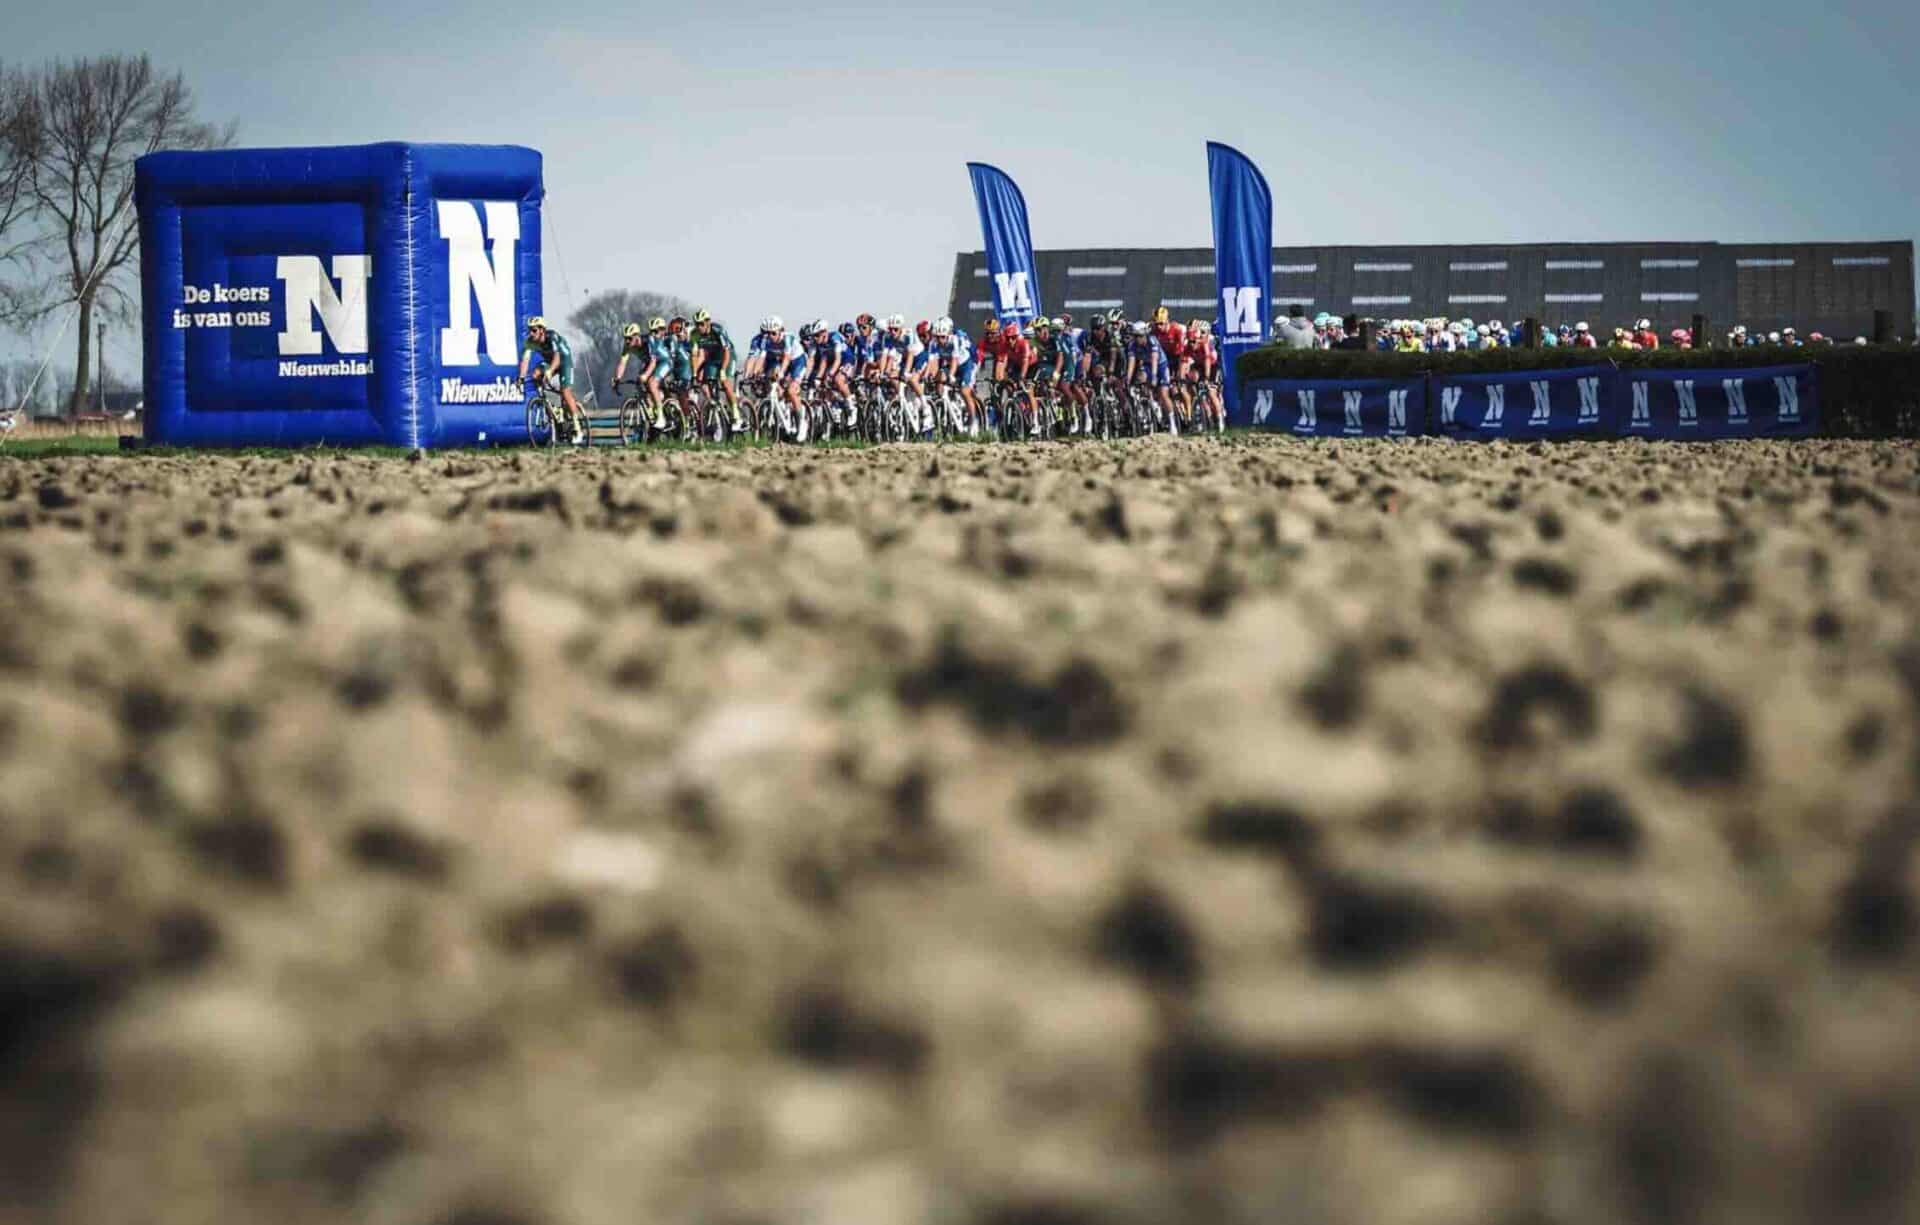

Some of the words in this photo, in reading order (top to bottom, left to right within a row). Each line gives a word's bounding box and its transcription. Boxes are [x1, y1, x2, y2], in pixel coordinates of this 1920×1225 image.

[184, 285, 211, 304] De
[213, 283, 270, 303] koers
[436, 200, 521, 367] N
[173, 308, 191, 329] is
[194, 311, 233, 328] van
[235, 311, 271, 327] ons
[276, 255, 373, 356] N
[278, 359, 374, 377] Nieuwsblad
[1297, 389, 1317, 426] N
[1343, 391, 1362, 426] N
[1388, 389, 1408, 427] N
[1484, 384, 1504, 421] N
[1529, 380, 1550, 418] N
[1577, 376, 1600, 416] N
[1631, 381, 1649, 419] N
[1673, 379, 1697, 418] N
[1722, 378, 1747, 415] N
[1773, 376, 1799, 415] N
